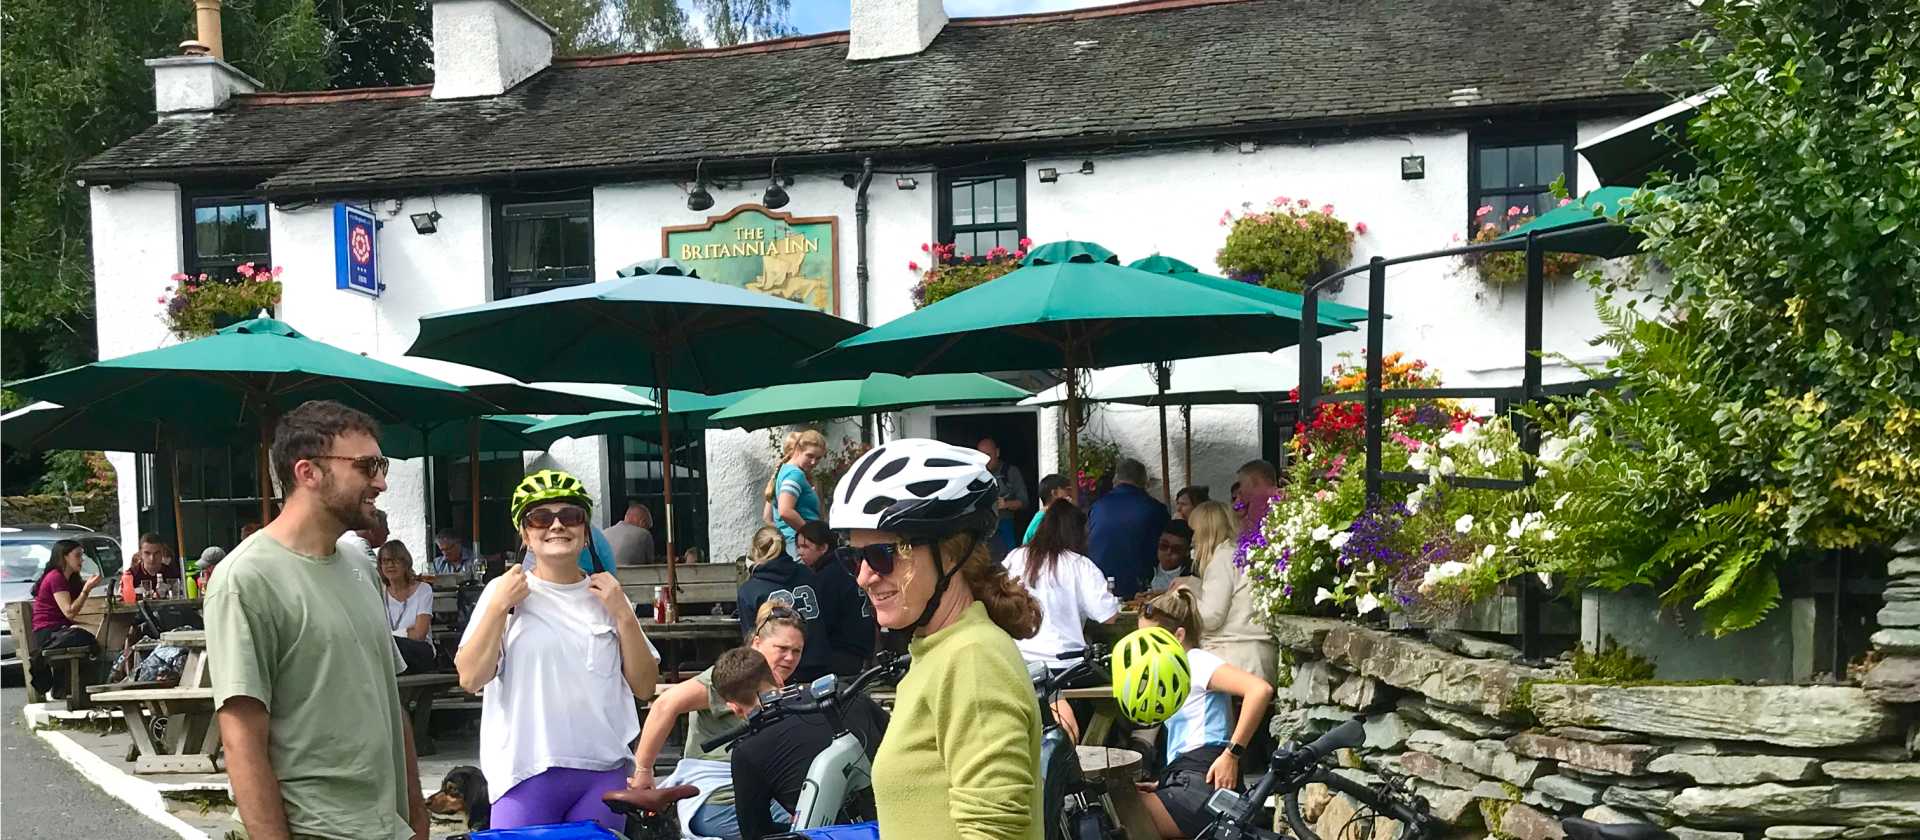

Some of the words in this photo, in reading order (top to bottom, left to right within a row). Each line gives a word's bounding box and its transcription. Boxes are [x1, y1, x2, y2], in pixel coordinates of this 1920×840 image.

[735, 227, 764, 240] THE
[682, 241, 779, 261] BRITANNIA
[784, 237, 819, 254] INN
